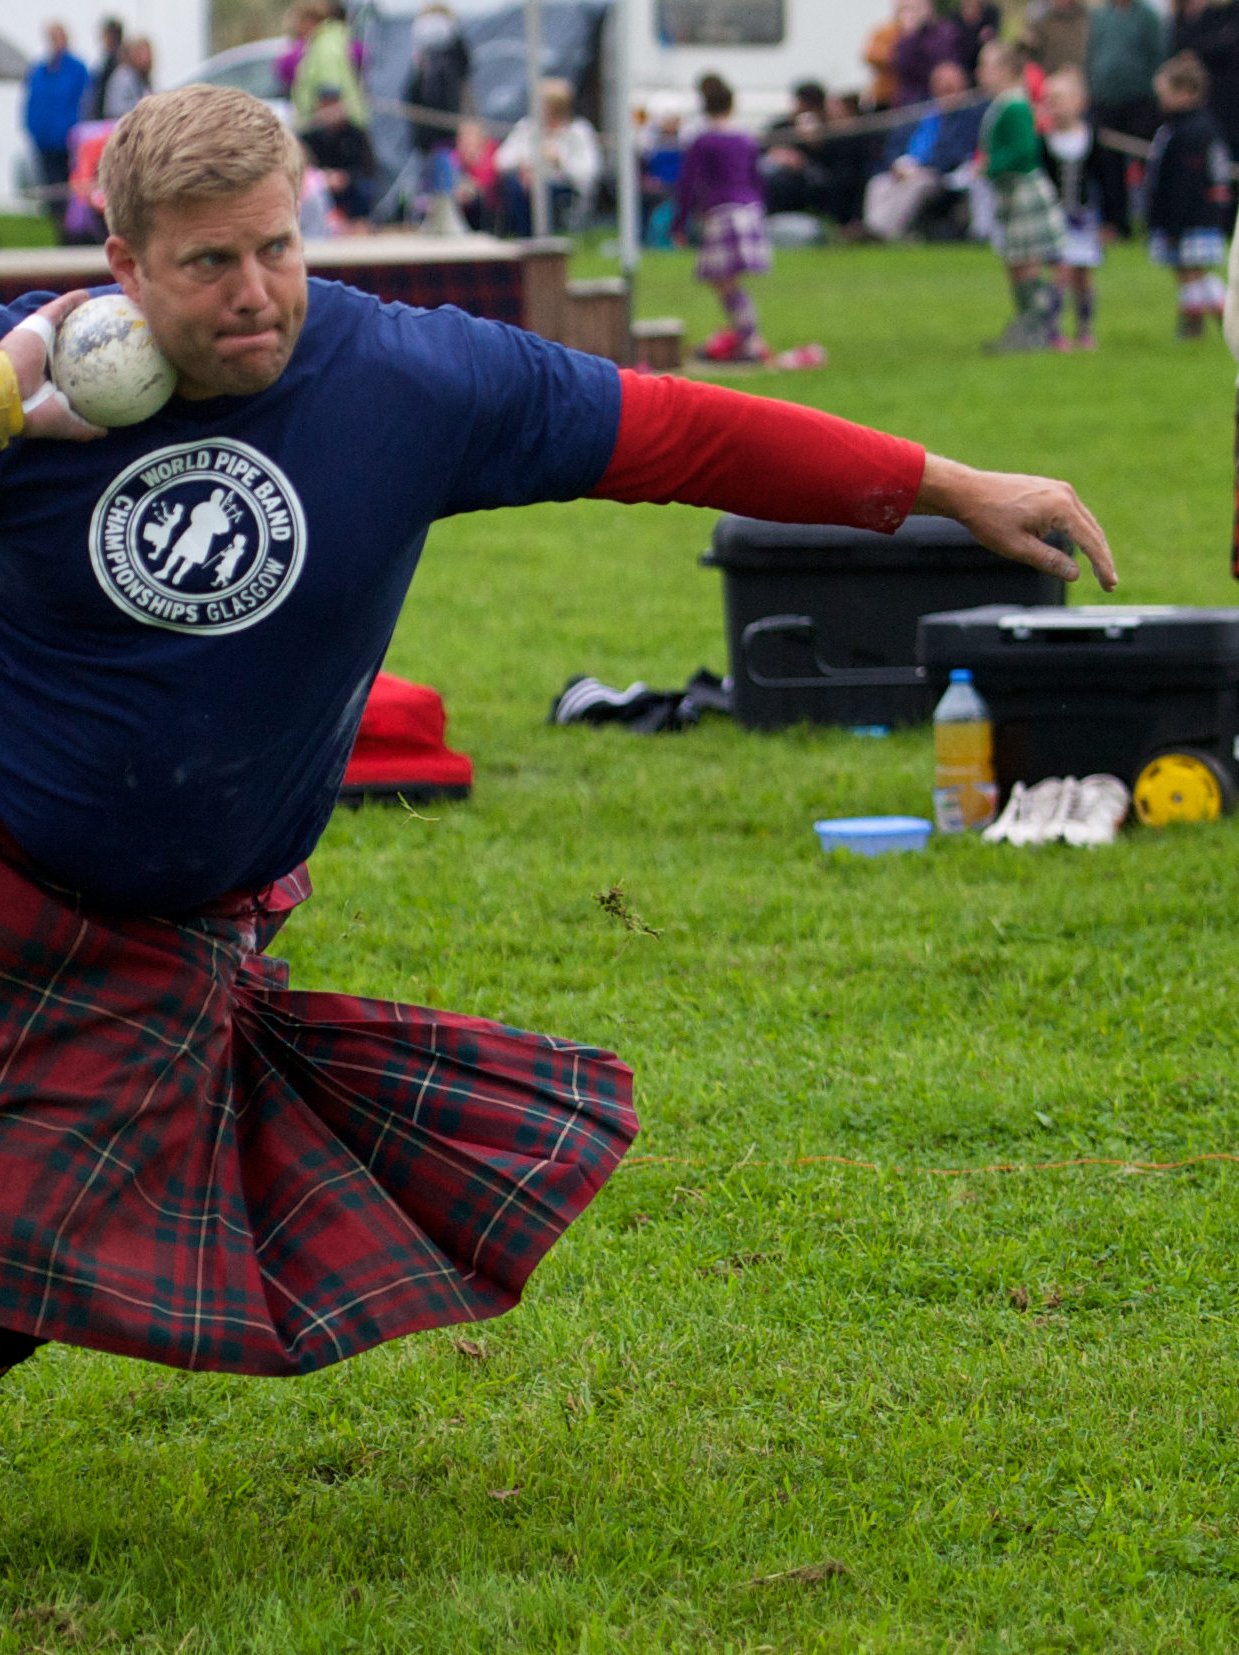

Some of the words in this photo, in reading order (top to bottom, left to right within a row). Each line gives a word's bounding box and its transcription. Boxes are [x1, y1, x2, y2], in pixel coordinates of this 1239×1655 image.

[140, 450, 210, 488] WORLD
[214, 452, 261, 486] PIPE
[254, 479, 292, 541] BAND
[103, 495, 198, 623] CHAMPIONSHIPS
[206, 557, 285, 622] GLASGOW
